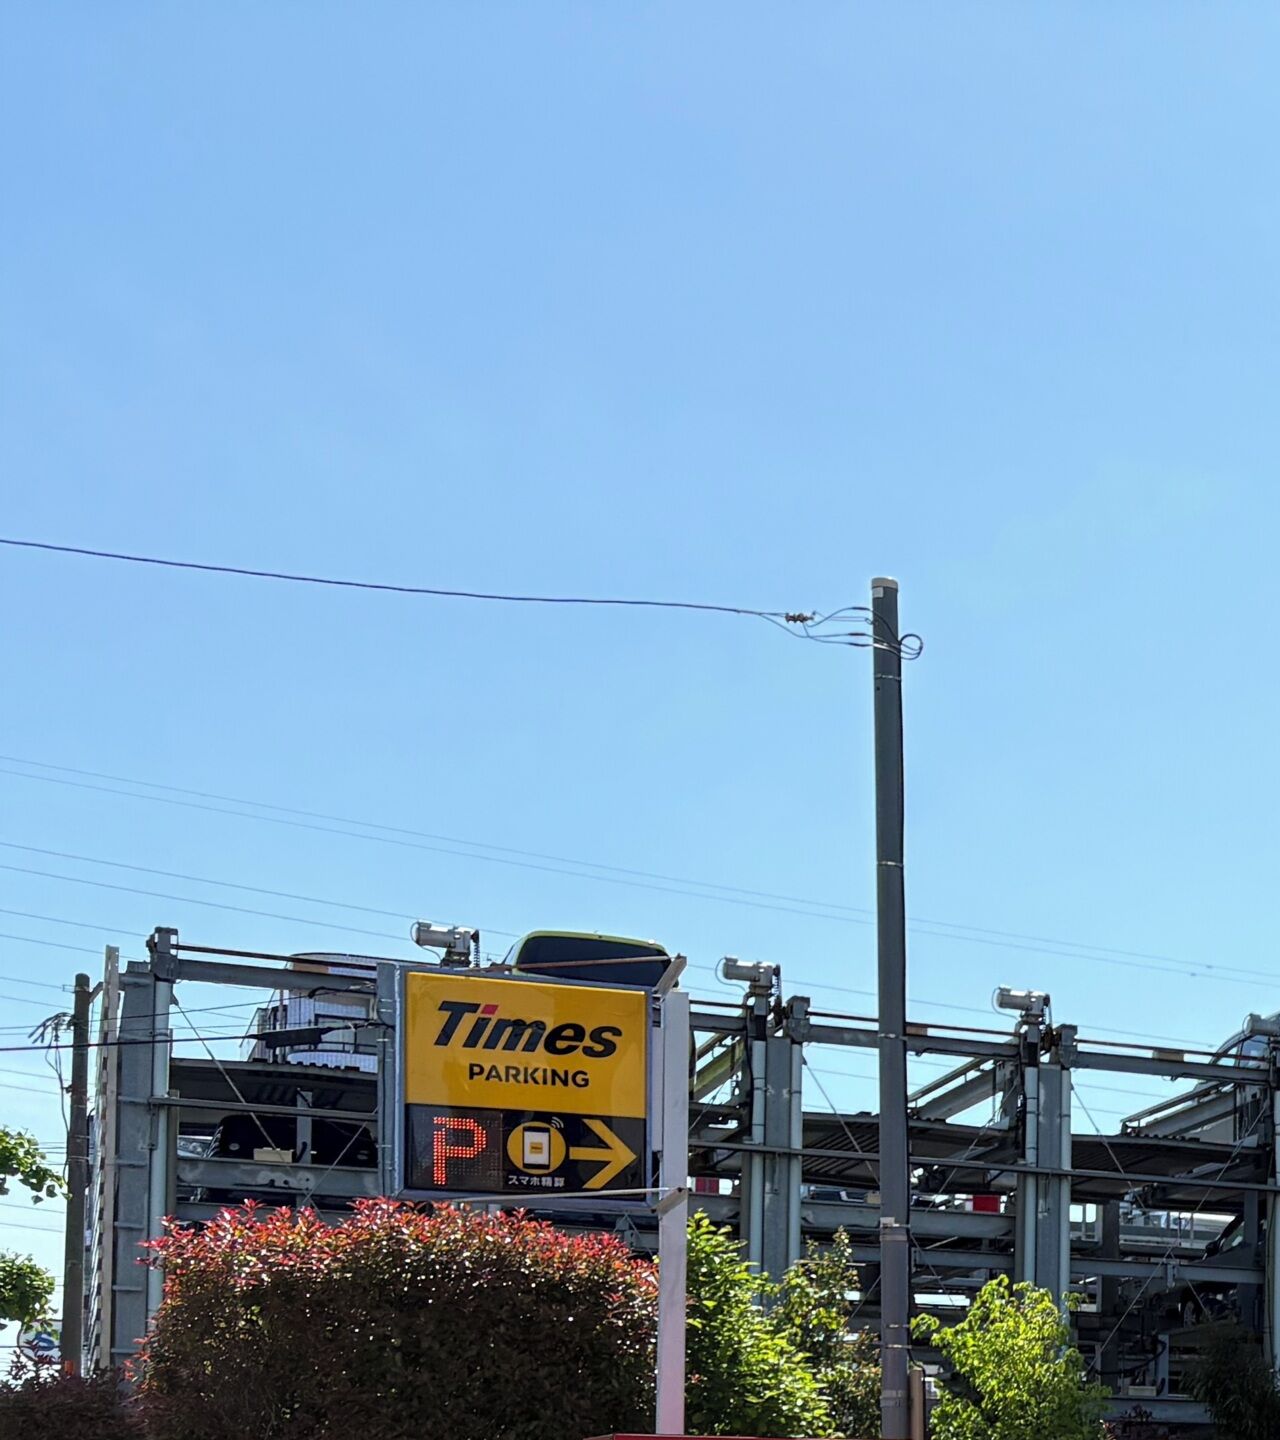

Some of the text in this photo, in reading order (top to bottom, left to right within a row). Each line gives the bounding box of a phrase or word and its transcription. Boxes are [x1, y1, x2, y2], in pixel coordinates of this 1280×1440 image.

[434, 1000, 622, 1058] Times
[469, 1063, 589, 1088] PARKING
[433, 1116, 487, 1185] P
